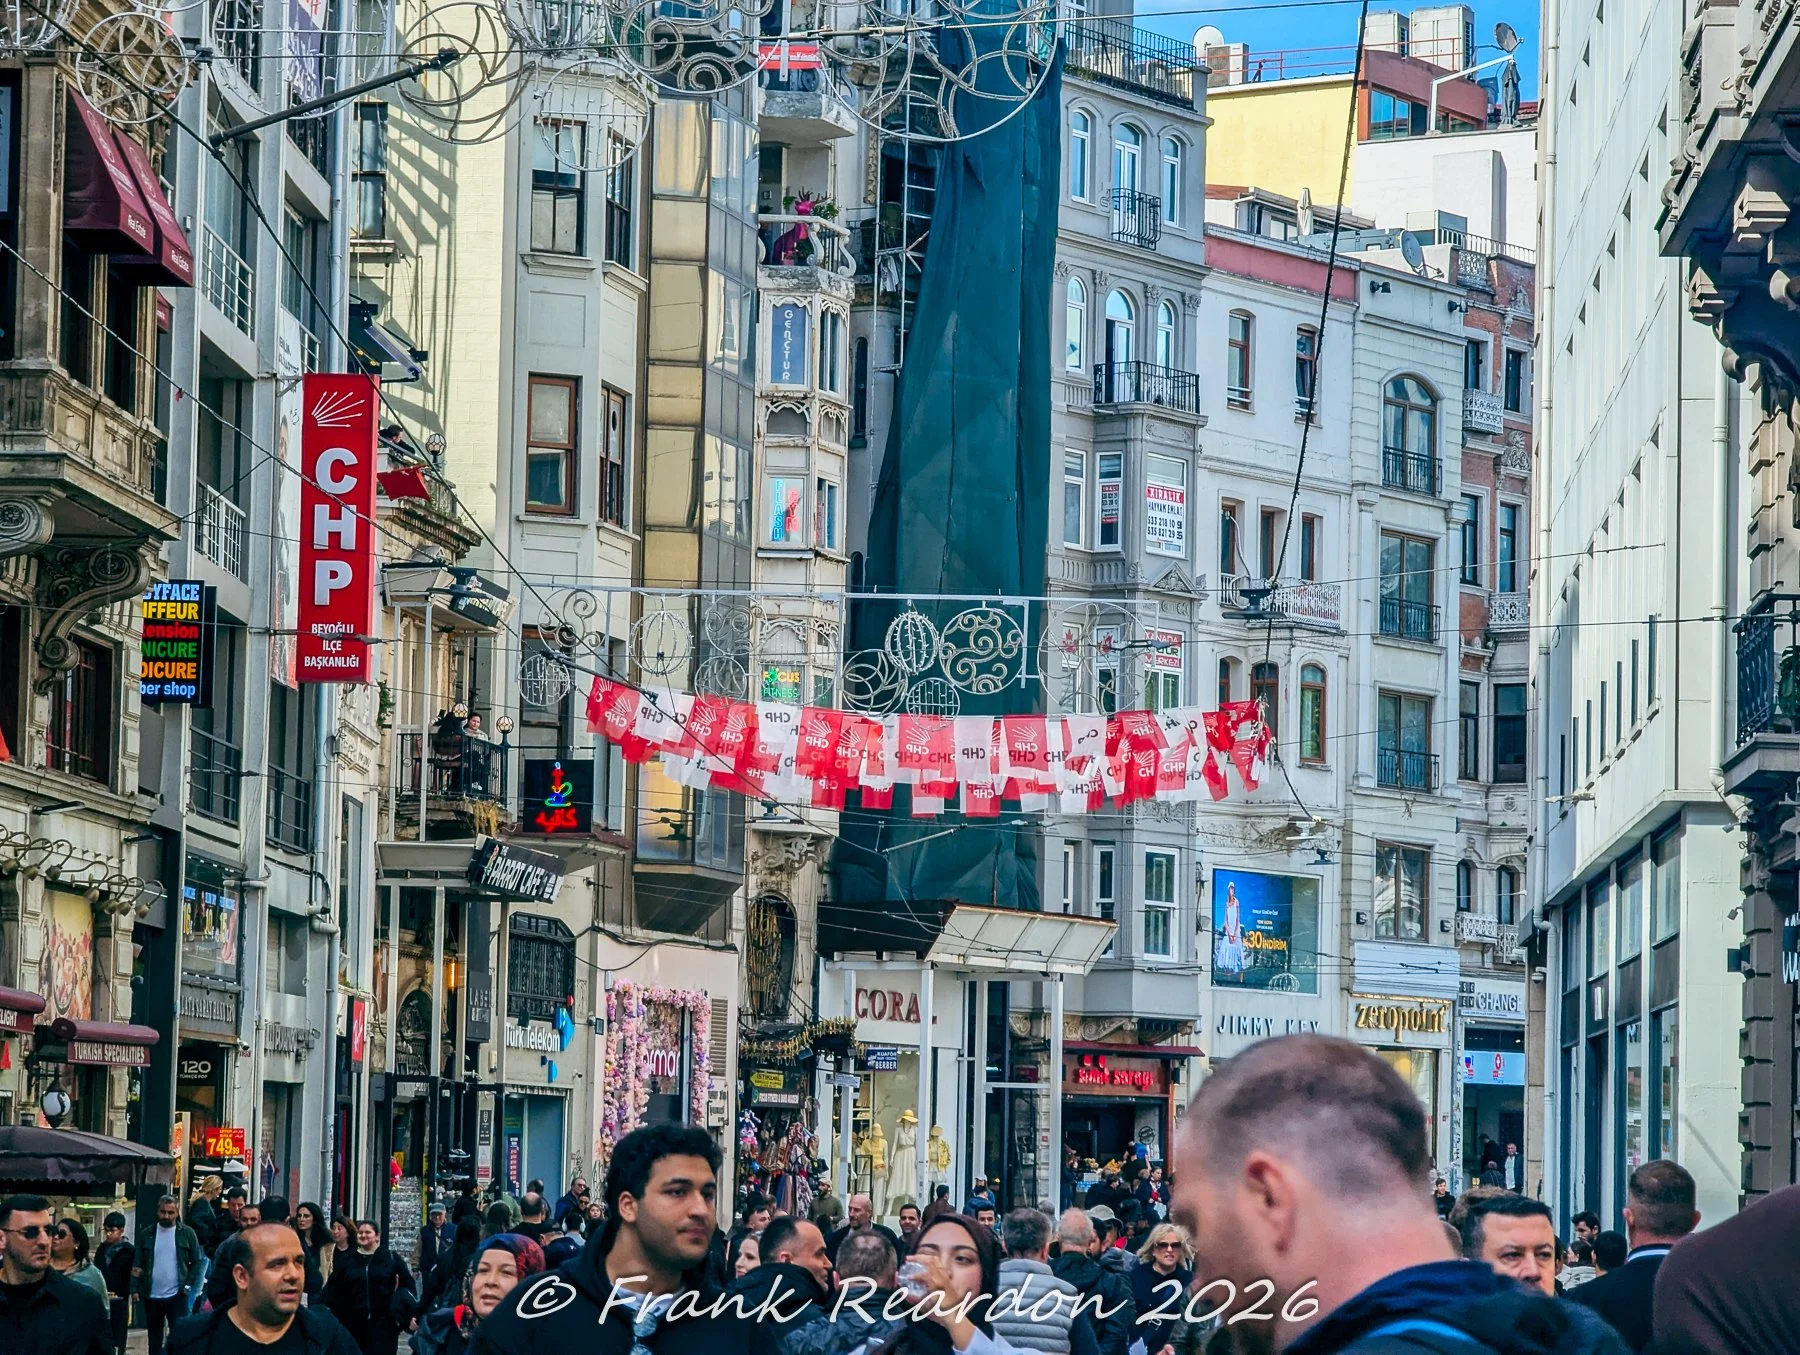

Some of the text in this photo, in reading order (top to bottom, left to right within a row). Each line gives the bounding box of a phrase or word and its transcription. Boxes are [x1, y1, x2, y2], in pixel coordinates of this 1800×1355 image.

[773, 479, 784, 541] FLASH
[313, 447, 358, 606] CHP
[312, 622, 354, 634] BEYOĞLU
[304, 655, 359, 670] BAŞKANLIĞI
[164, 682, 196, 698] shop
[1163, 762, 1185, 773] CHP
[487, 856, 545, 897] PARROT CAFE
[855, 987, 938, 1025] CORA
[1216, 1015, 1275, 1037] JIMMY
[1355, 1002, 1450, 1044] zeropoint
[506, 1024, 561, 1053] Türk Telekom
[74, 1041, 146, 1064] TURKISH SPECIALITIES
[181, 1060, 212, 1074] 120
[875, 1060, 897, 1070] BERBER
